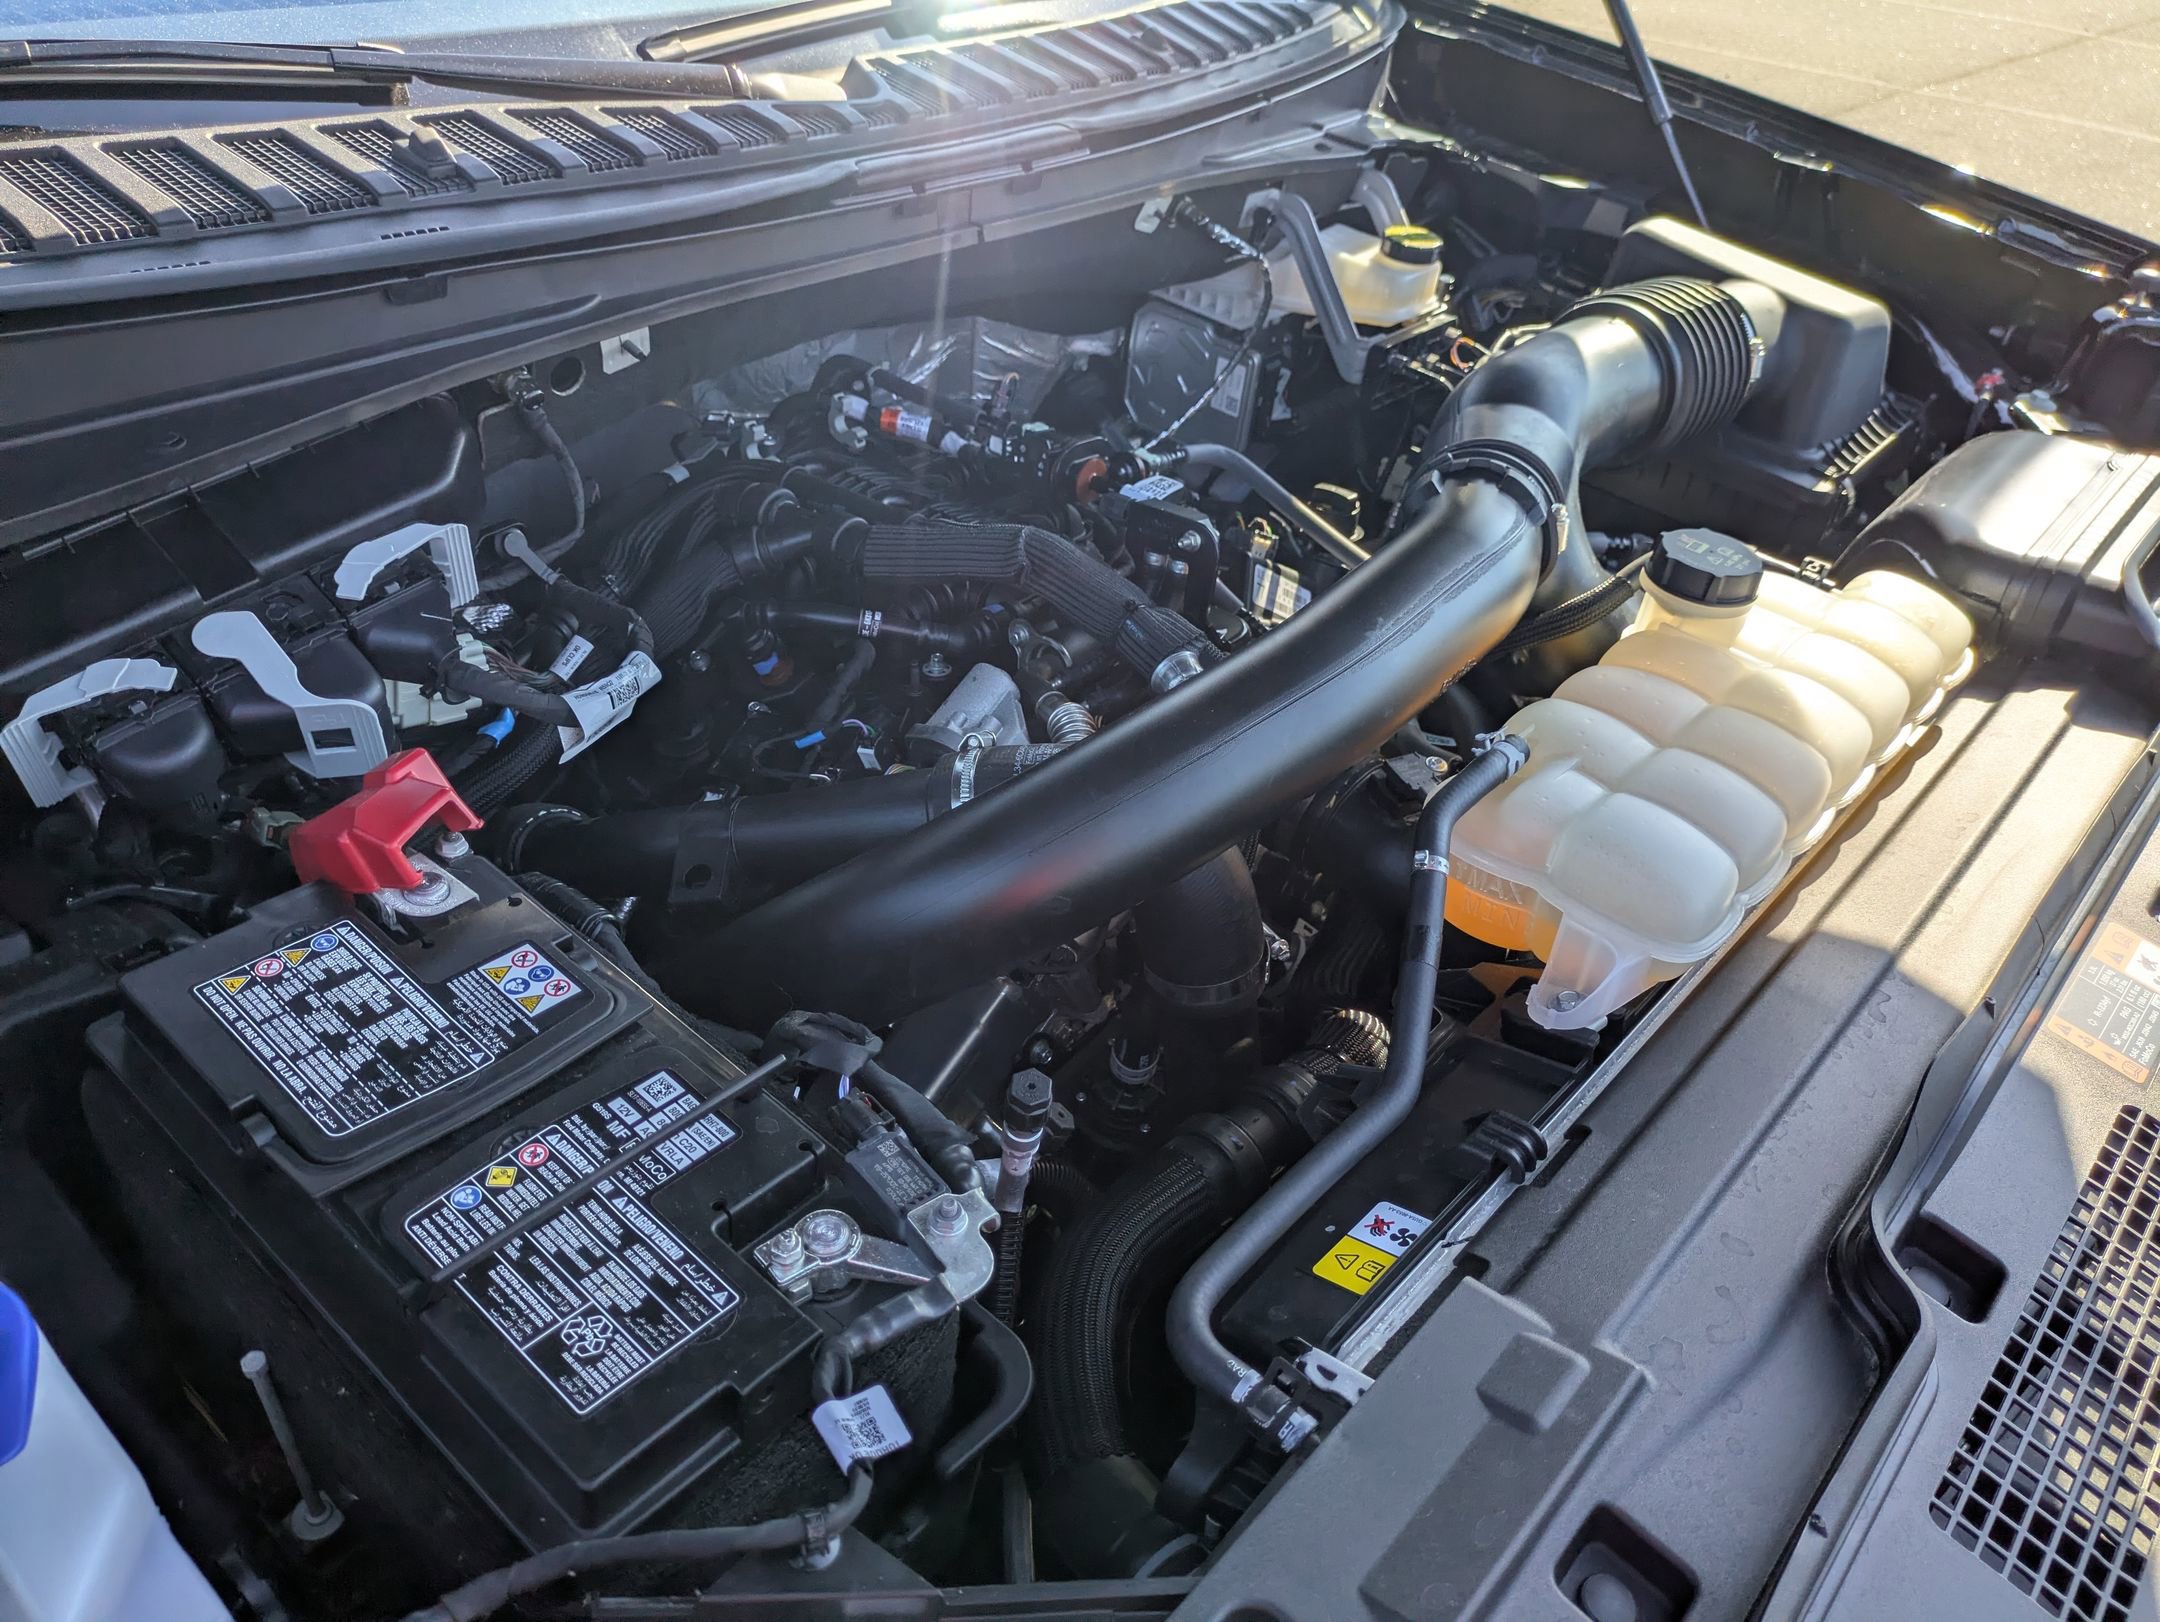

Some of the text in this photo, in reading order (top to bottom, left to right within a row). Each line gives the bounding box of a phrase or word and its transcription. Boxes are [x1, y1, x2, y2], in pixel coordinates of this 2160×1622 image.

[561, 651, 575, 667] CLIPS
[1469, 868, 1525, 905] MAX
[1464, 895, 1520, 929] MIN
[342, 931, 394, 974] DANGER/POISON
[396, 982, 451, 1028] PELIGRO/VENENO
[201, 986, 217, 996] DO
[208, 993, 226, 1006] NOT
[2118, 1005, 2132, 1019] PAG
[233, 1019, 248, 1029] NE
[240, 1026, 258, 1040] PAS
[2128, 1046, 2140, 1059] SAE
[2137, 1041, 2156, 1065] FoMoCo
[271, 1059, 287, 1070] NO
[278, 1067, 294, 1078] LA
[614, 1102, 634, 1118] 12V
[605, 1119, 631, 1141] MF
[659, 1143, 684, 1165] VRLA
[677, 1137, 698, 1154] C20
[554, 1139, 614, 1194] DANGER/PON
[625, 1141, 669, 1181] FMoCo
[545, 1160, 560, 1172] KEEP
[554, 1168, 568, 1180] OUT
[561, 1175, 573, 1185] OF
[420, 1217, 450, 1248] Batterie au
[430, 1211, 460, 1239] Lead Acid
[439, 1206, 480, 1246] NON-SPILLAB
[621, 1203, 685, 1261] PELIGRO/VENENO
[410, 1223, 468, 1281] ANTI DÉVERSET
[495, 1263, 554, 1323] CONTRA DERRAMES
[505, 1287, 514, 1295] de
[508, 1292, 529, 1311] plomo
[580, 1327, 596, 1341] Pb
